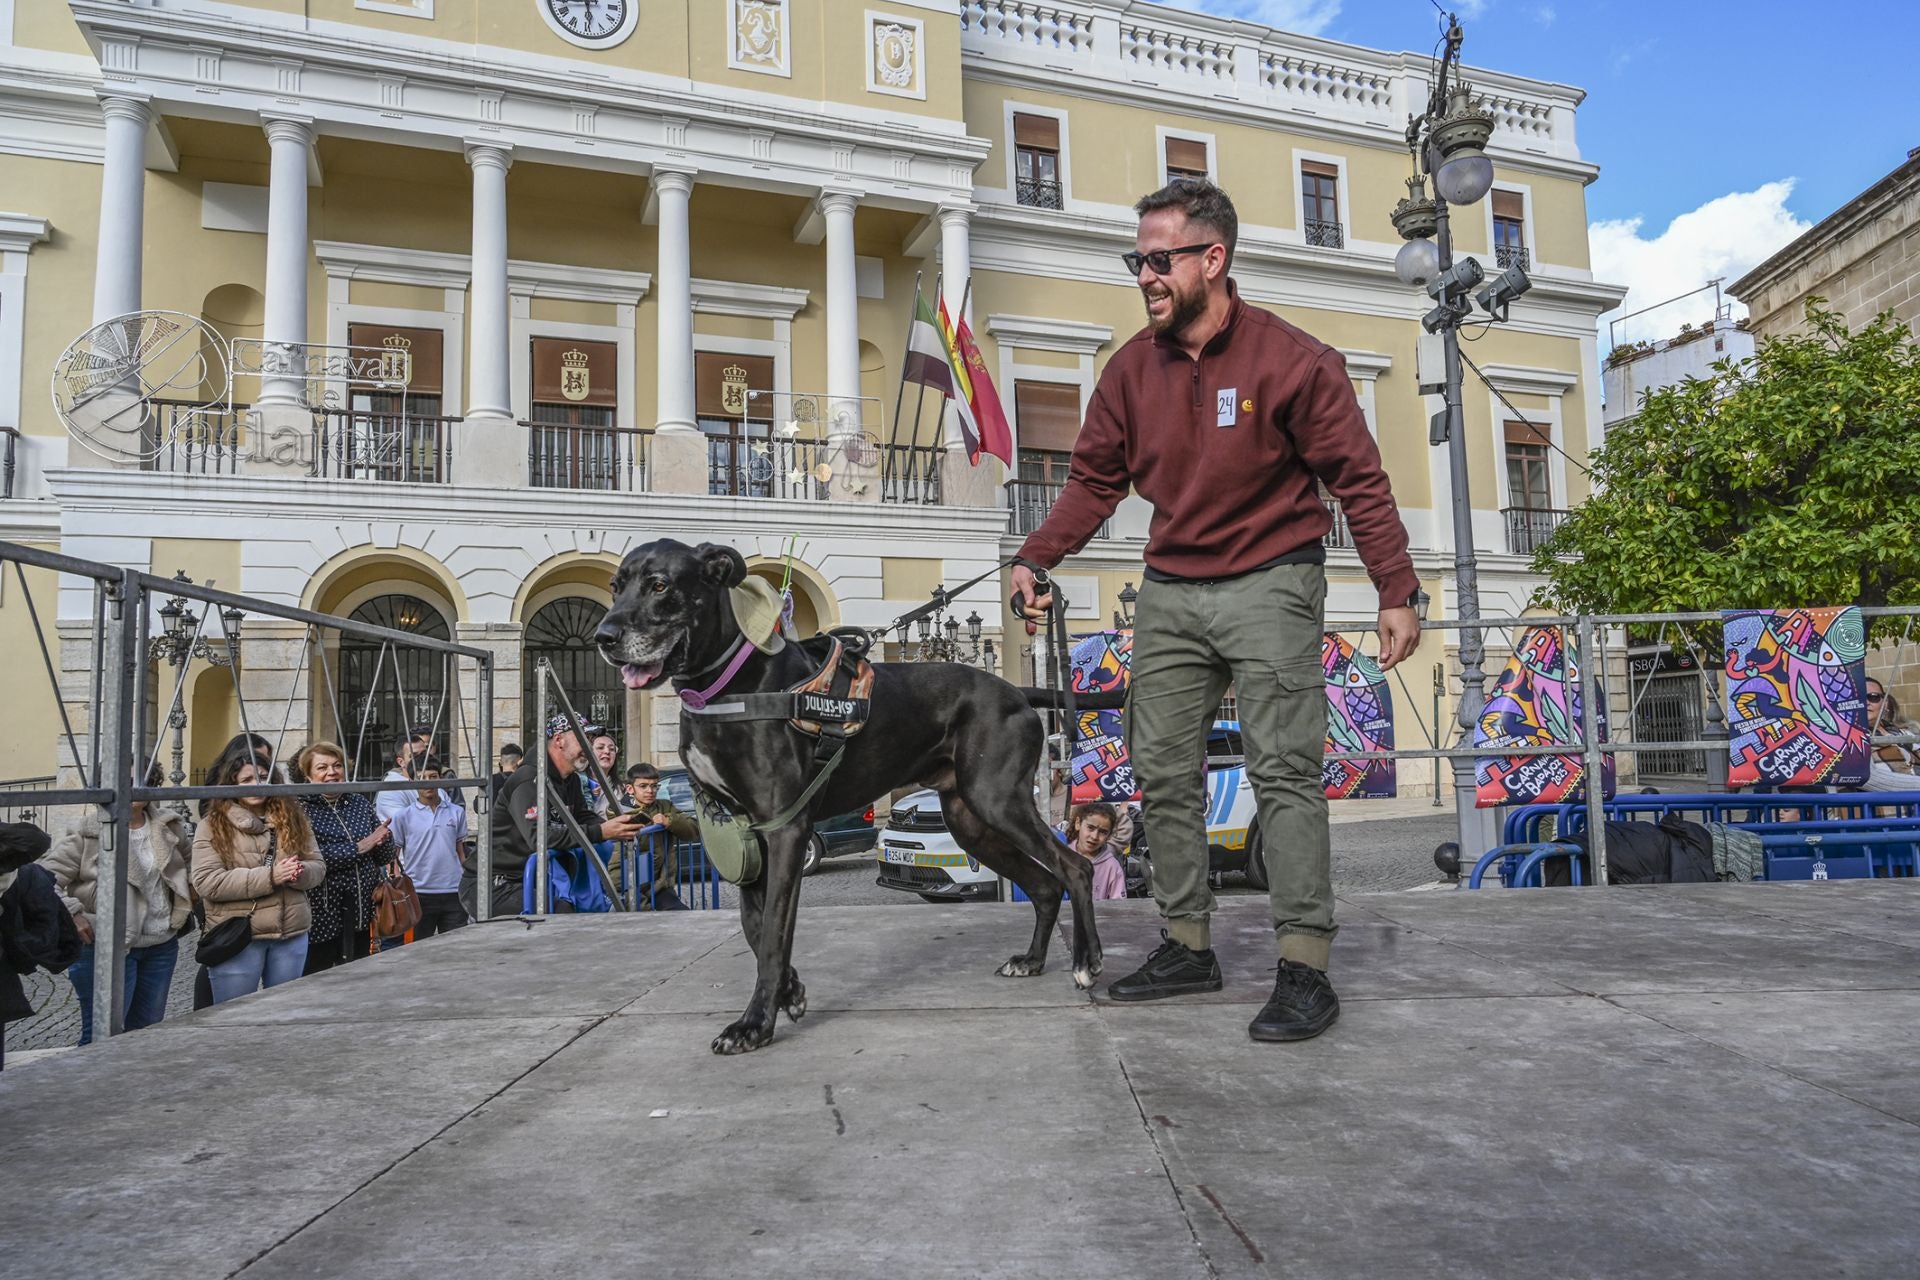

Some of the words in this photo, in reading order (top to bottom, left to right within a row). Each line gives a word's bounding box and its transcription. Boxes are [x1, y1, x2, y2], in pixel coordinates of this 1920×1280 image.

[235, 341, 400, 380] Carnaval
[296, 380, 341, 410] de
[1217, 396, 1234, 417] 24
[1758, 735, 1811, 772] CARNAVAL
[1769, 770, 1780, 779] DE
[1778, 742, 1818, 779] BADAJOZ
[1805, 752, 1823, 769] 2025
[1517, 789, 1527, 797] DE
[1525, 758, 1563, 796] BADAJOZ
[1550, 768, 1568, 786] 2025
[1111, 788, 1121, 797] DE
